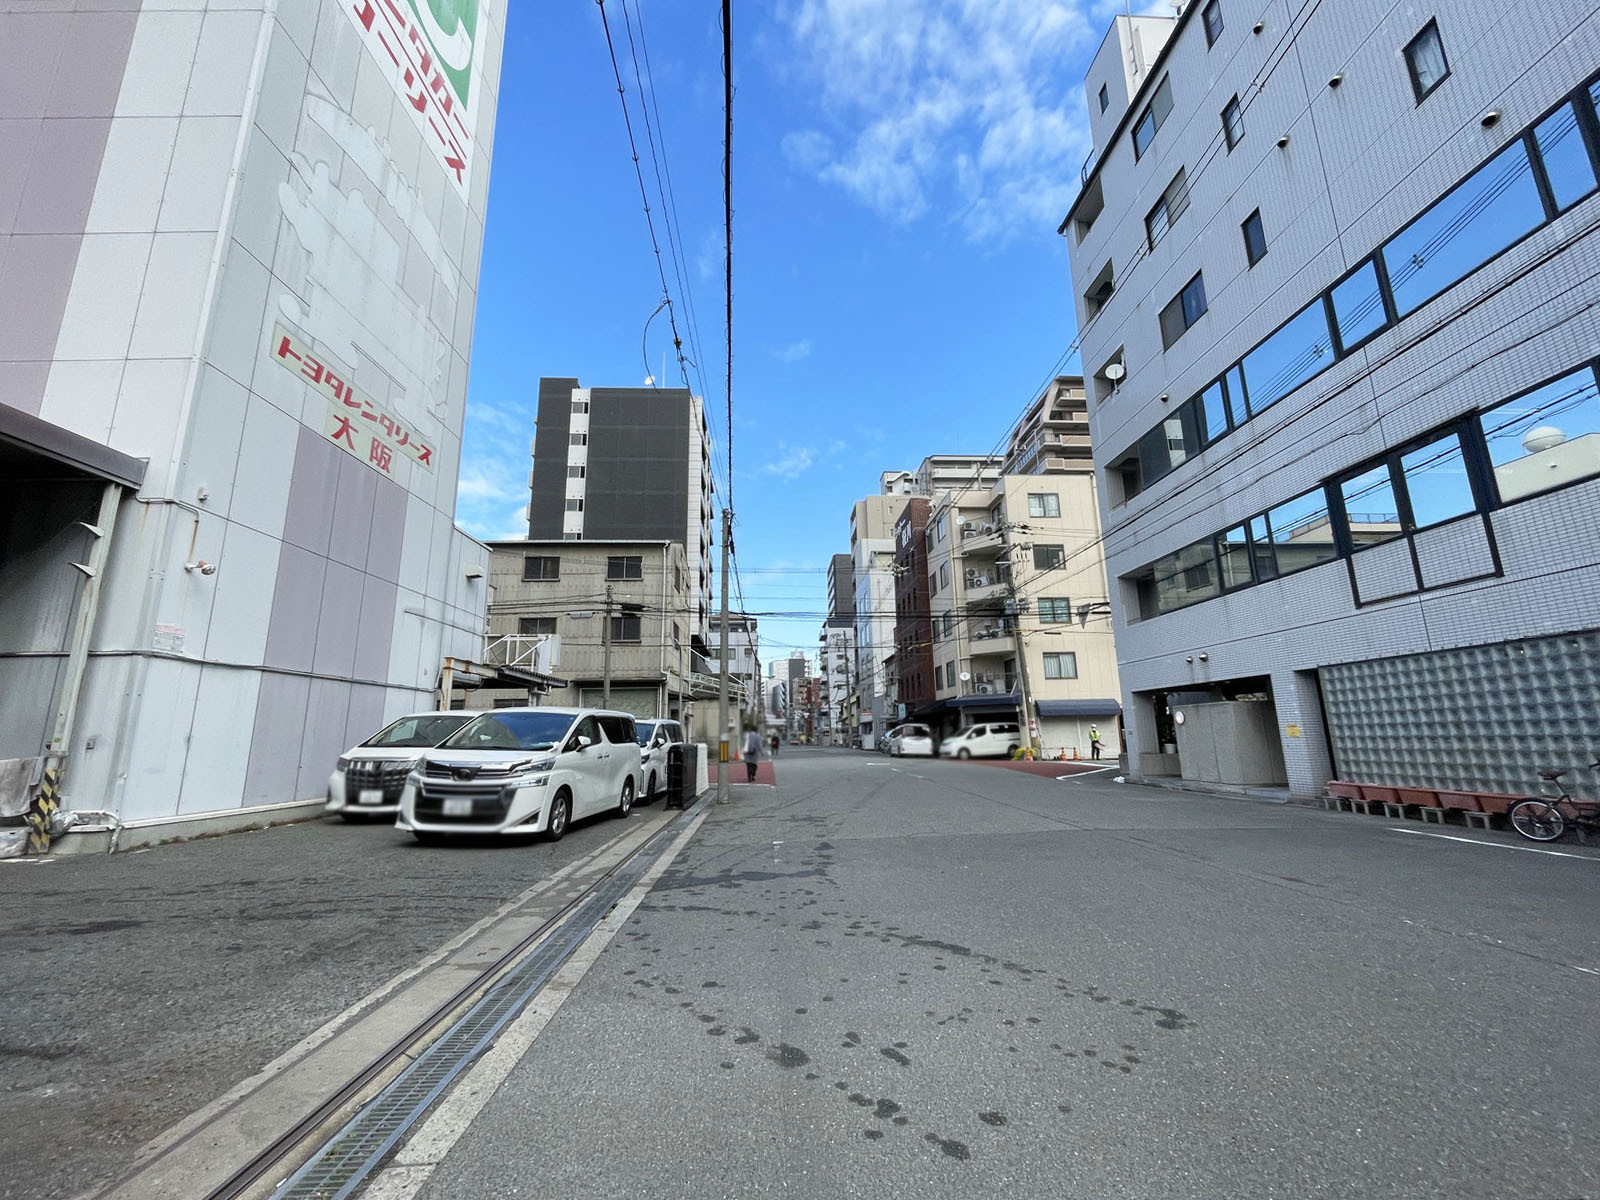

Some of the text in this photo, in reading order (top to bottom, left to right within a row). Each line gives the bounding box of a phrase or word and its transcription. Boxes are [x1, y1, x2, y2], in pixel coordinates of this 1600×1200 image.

[278, 336, 432, 466] トヨタレンタリース
[331, 414, 393, 473] 大阪
